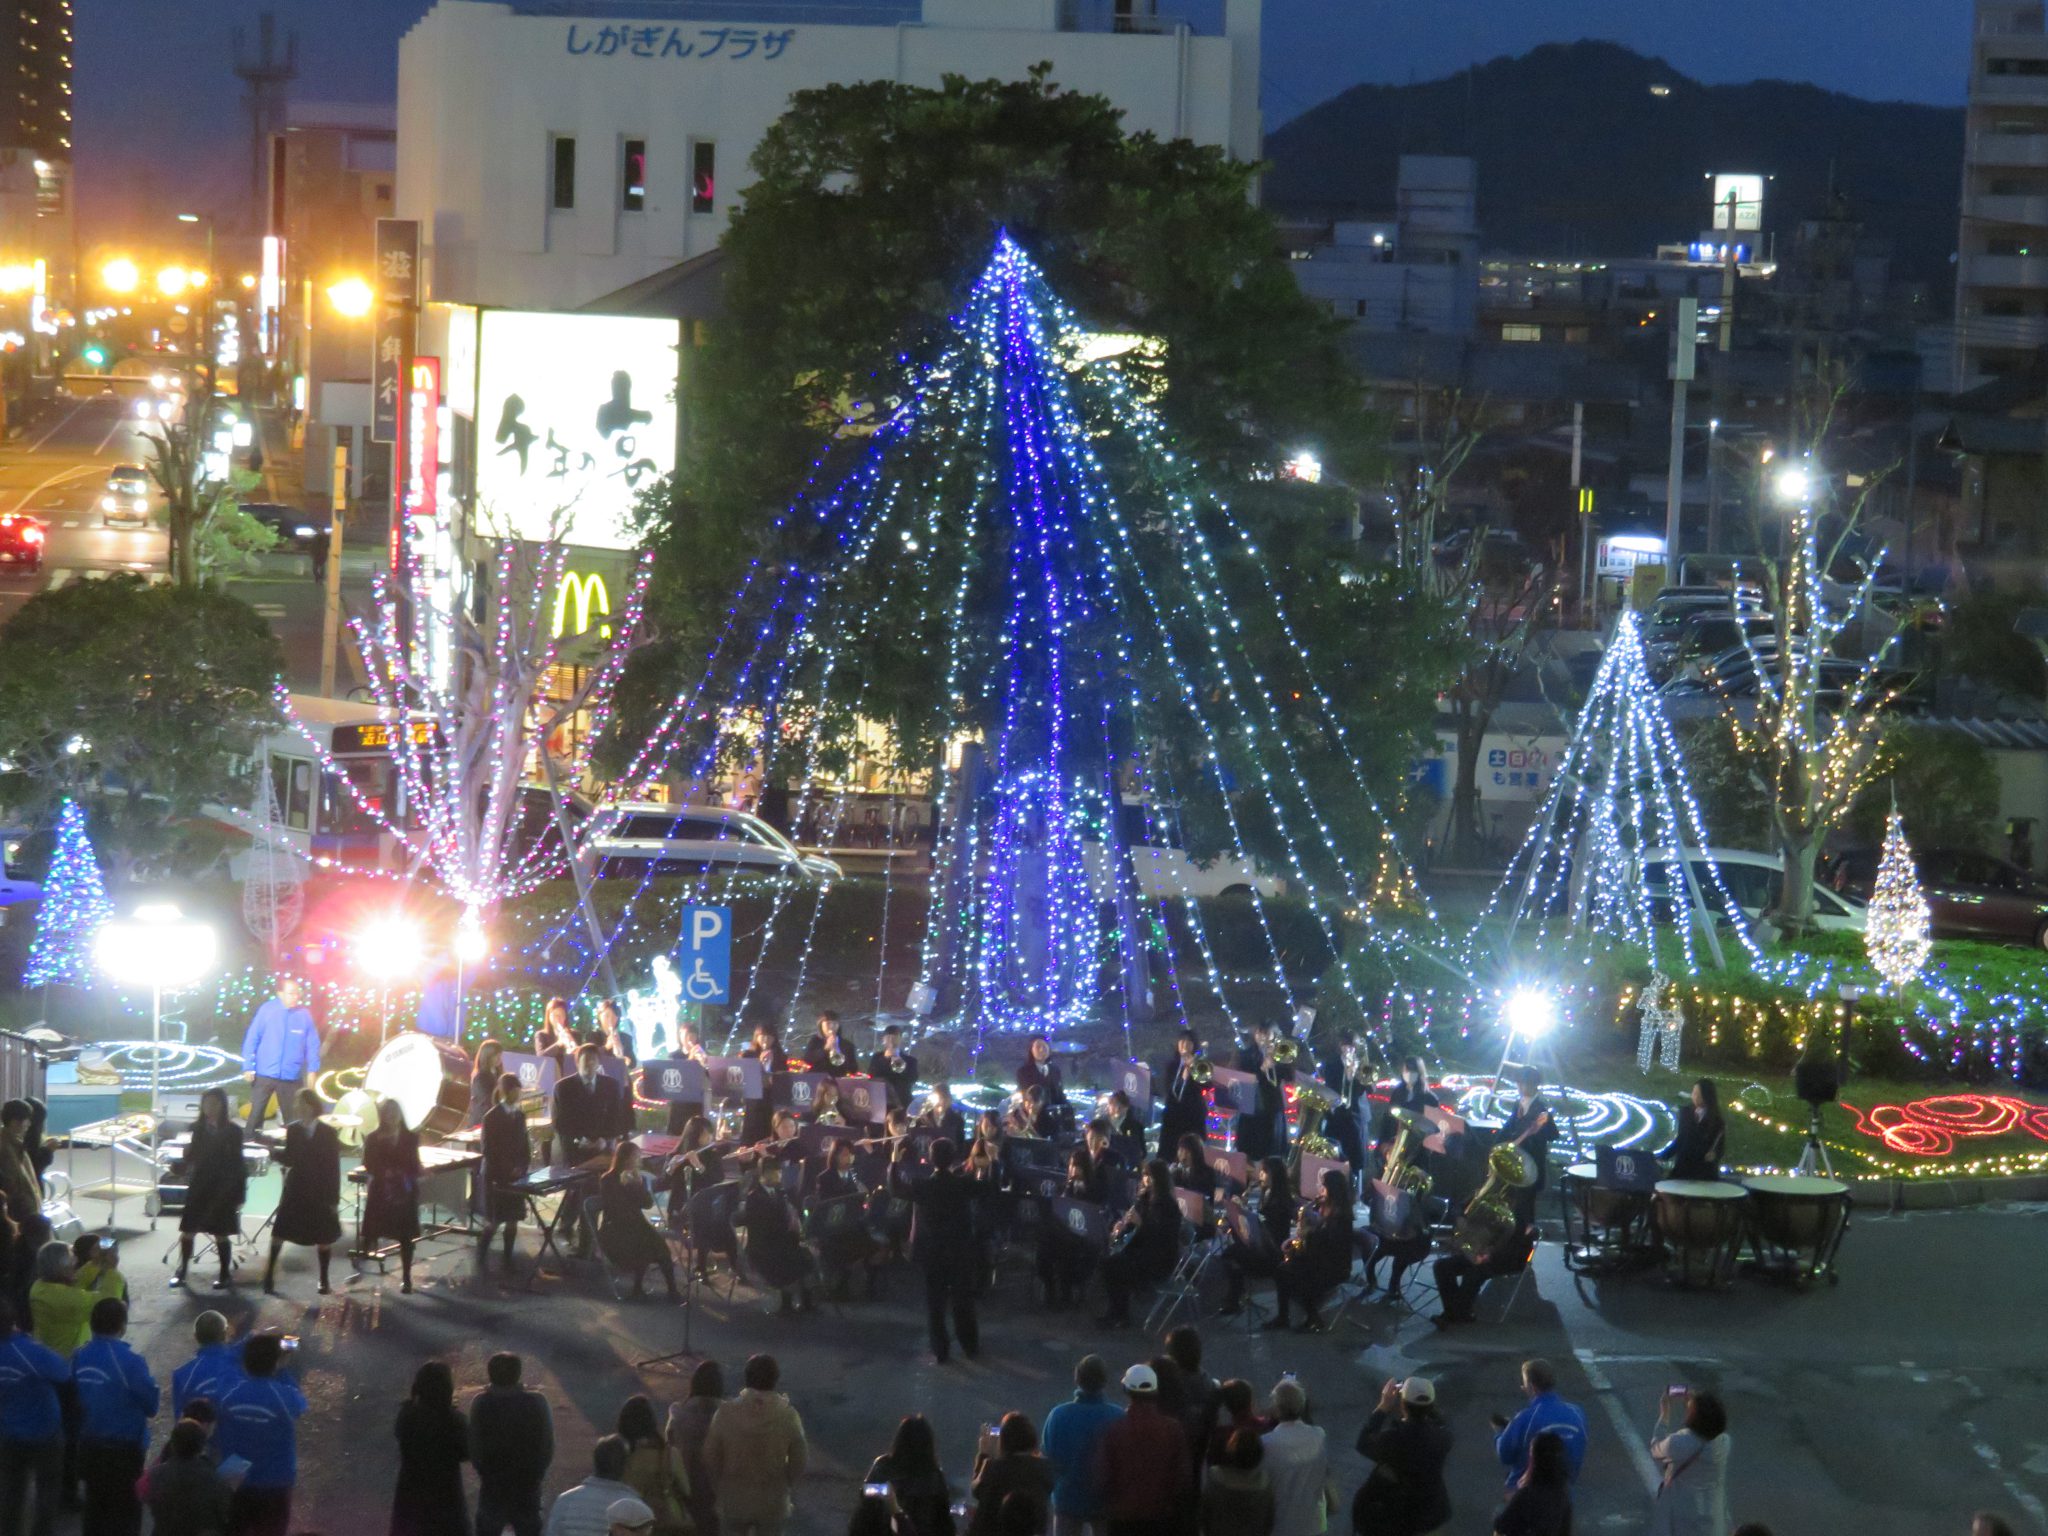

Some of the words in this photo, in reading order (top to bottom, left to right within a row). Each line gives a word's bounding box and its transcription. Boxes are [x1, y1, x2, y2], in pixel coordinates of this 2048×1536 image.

[567, 24, 795, 60] しがぎんプラザ
[495, 370, 657, 488] 千年の宴
[693, 910, 722, 951] P
